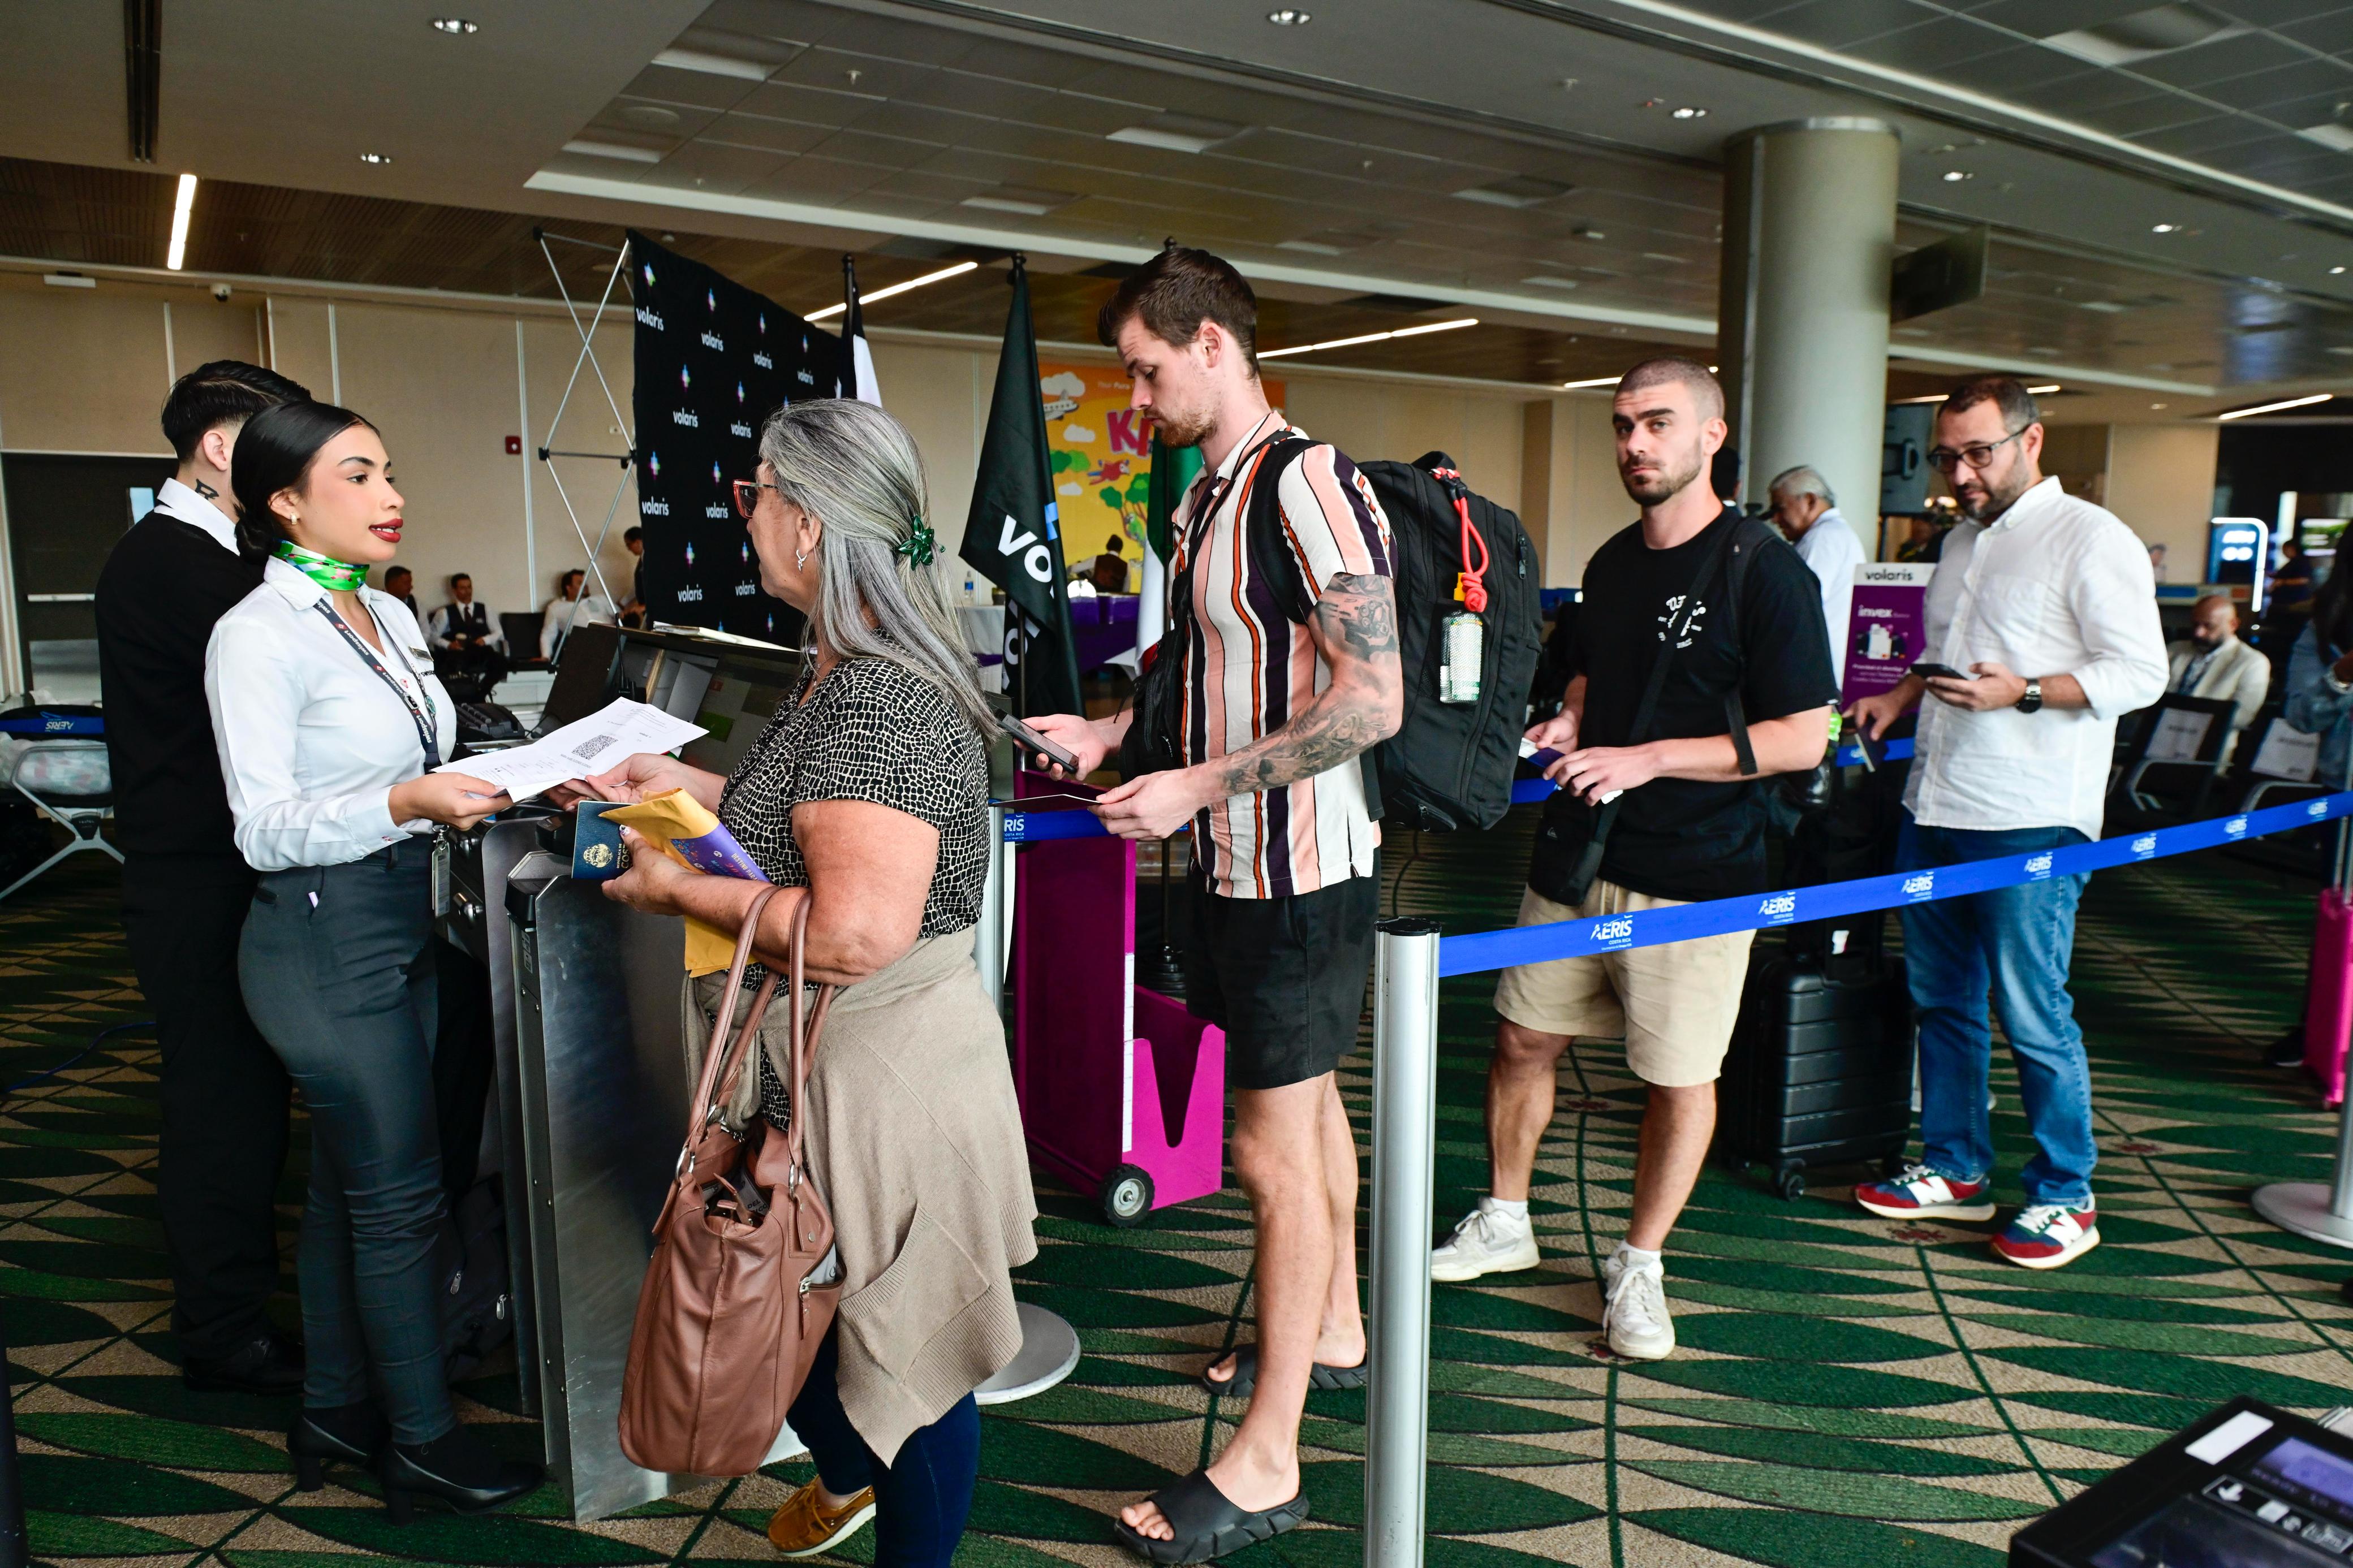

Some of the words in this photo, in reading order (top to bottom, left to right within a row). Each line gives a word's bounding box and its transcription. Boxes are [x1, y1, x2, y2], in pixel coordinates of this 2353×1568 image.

[636, 305, 664, 331] volaris
[701, 330, 724, 352] volaris
[753, 351, 773, 370] volaris
[797, 369, 814, 385] volaris
[673, 407, 699, 429] volaris
[730, 420, 752, 439] volaris
[1107, 408, 1149, 457] KI
[641, 500, 670, 517] volaris
[705, 502, 729, 520] volaris
[998, 515, 1054, 599] vo
[1866, 569, 1914, 581] volaris
[677, 584, 703, 603] volaris
[735, 579, 756, 597] volaris
[344, 629, 369, 656] swissport
[382, 672, 403, 694] wissport
[45, 721, 75, 731] AERIS
[416, 715, 433, 744] swissport
[1004, 819, 1024, 832] RIS
[731, 853, 748, 871] DESTINO
[1901, 875, 1934, 894] AERIS
[1758, 896, 1796, 915] AERIS
[1590, 919, 1633, 940] AERIS
